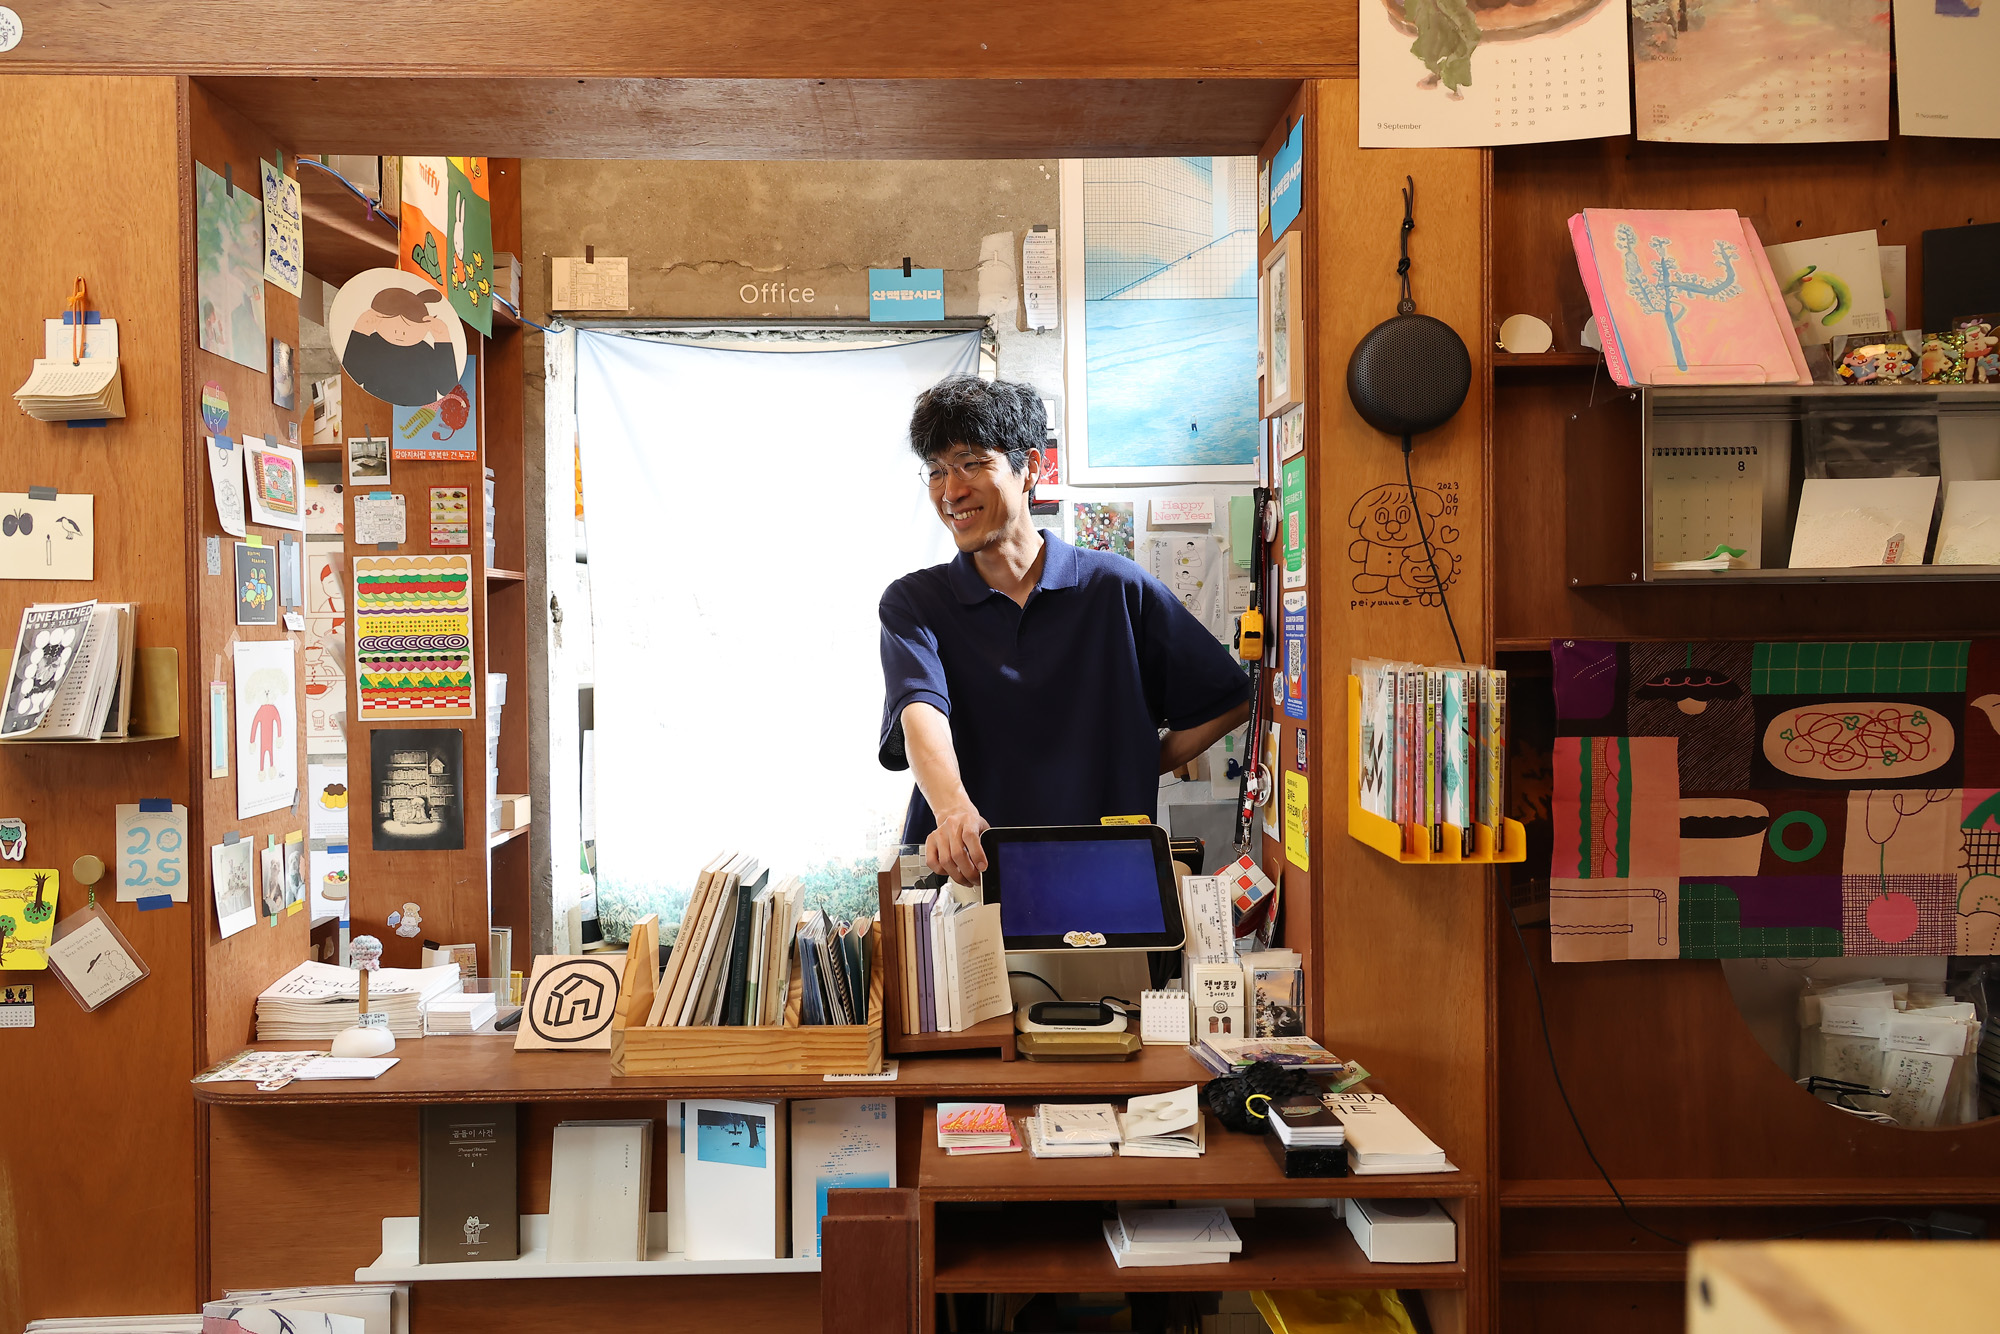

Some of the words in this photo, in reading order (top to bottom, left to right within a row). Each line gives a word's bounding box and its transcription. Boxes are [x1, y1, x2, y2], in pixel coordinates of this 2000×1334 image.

[1384, 122, 1421, 131] September
[418, 161, 440, 196] miffy
[740, 282, 814, 303] Office
[872, 290, 942, 301] 산책합시다
[1600, 316, 1612, 344] FLOWERS
[1608, 345, 1616, 355] OF
[1610, 355, 1624, 380] SHAPES
[395, 450, 426, 459] 강아지처럼
[1738, 461, 1745, 471] 8
[1437, 482, 1459, 490] 2023
[1446, 494, 1458, 504] 06
[1162, 500, 1204, 510] Happy
[1154, 512, 1182, 520] New
[1182, 512, 1212, 520] Year
[1445, 506, 1458, 516] 07
[28, 606, 92, 622] UNEARTHED
[126, 826, 182, 855] 20
[124, 858, 181, 886] 25
[279, 984, 323, 995] like
[1204, 980, 1236, 990] 책방풍경
[861, 1103, 887, 1111] 숨김없는
[478, 1129, 492, 1137] 사전
